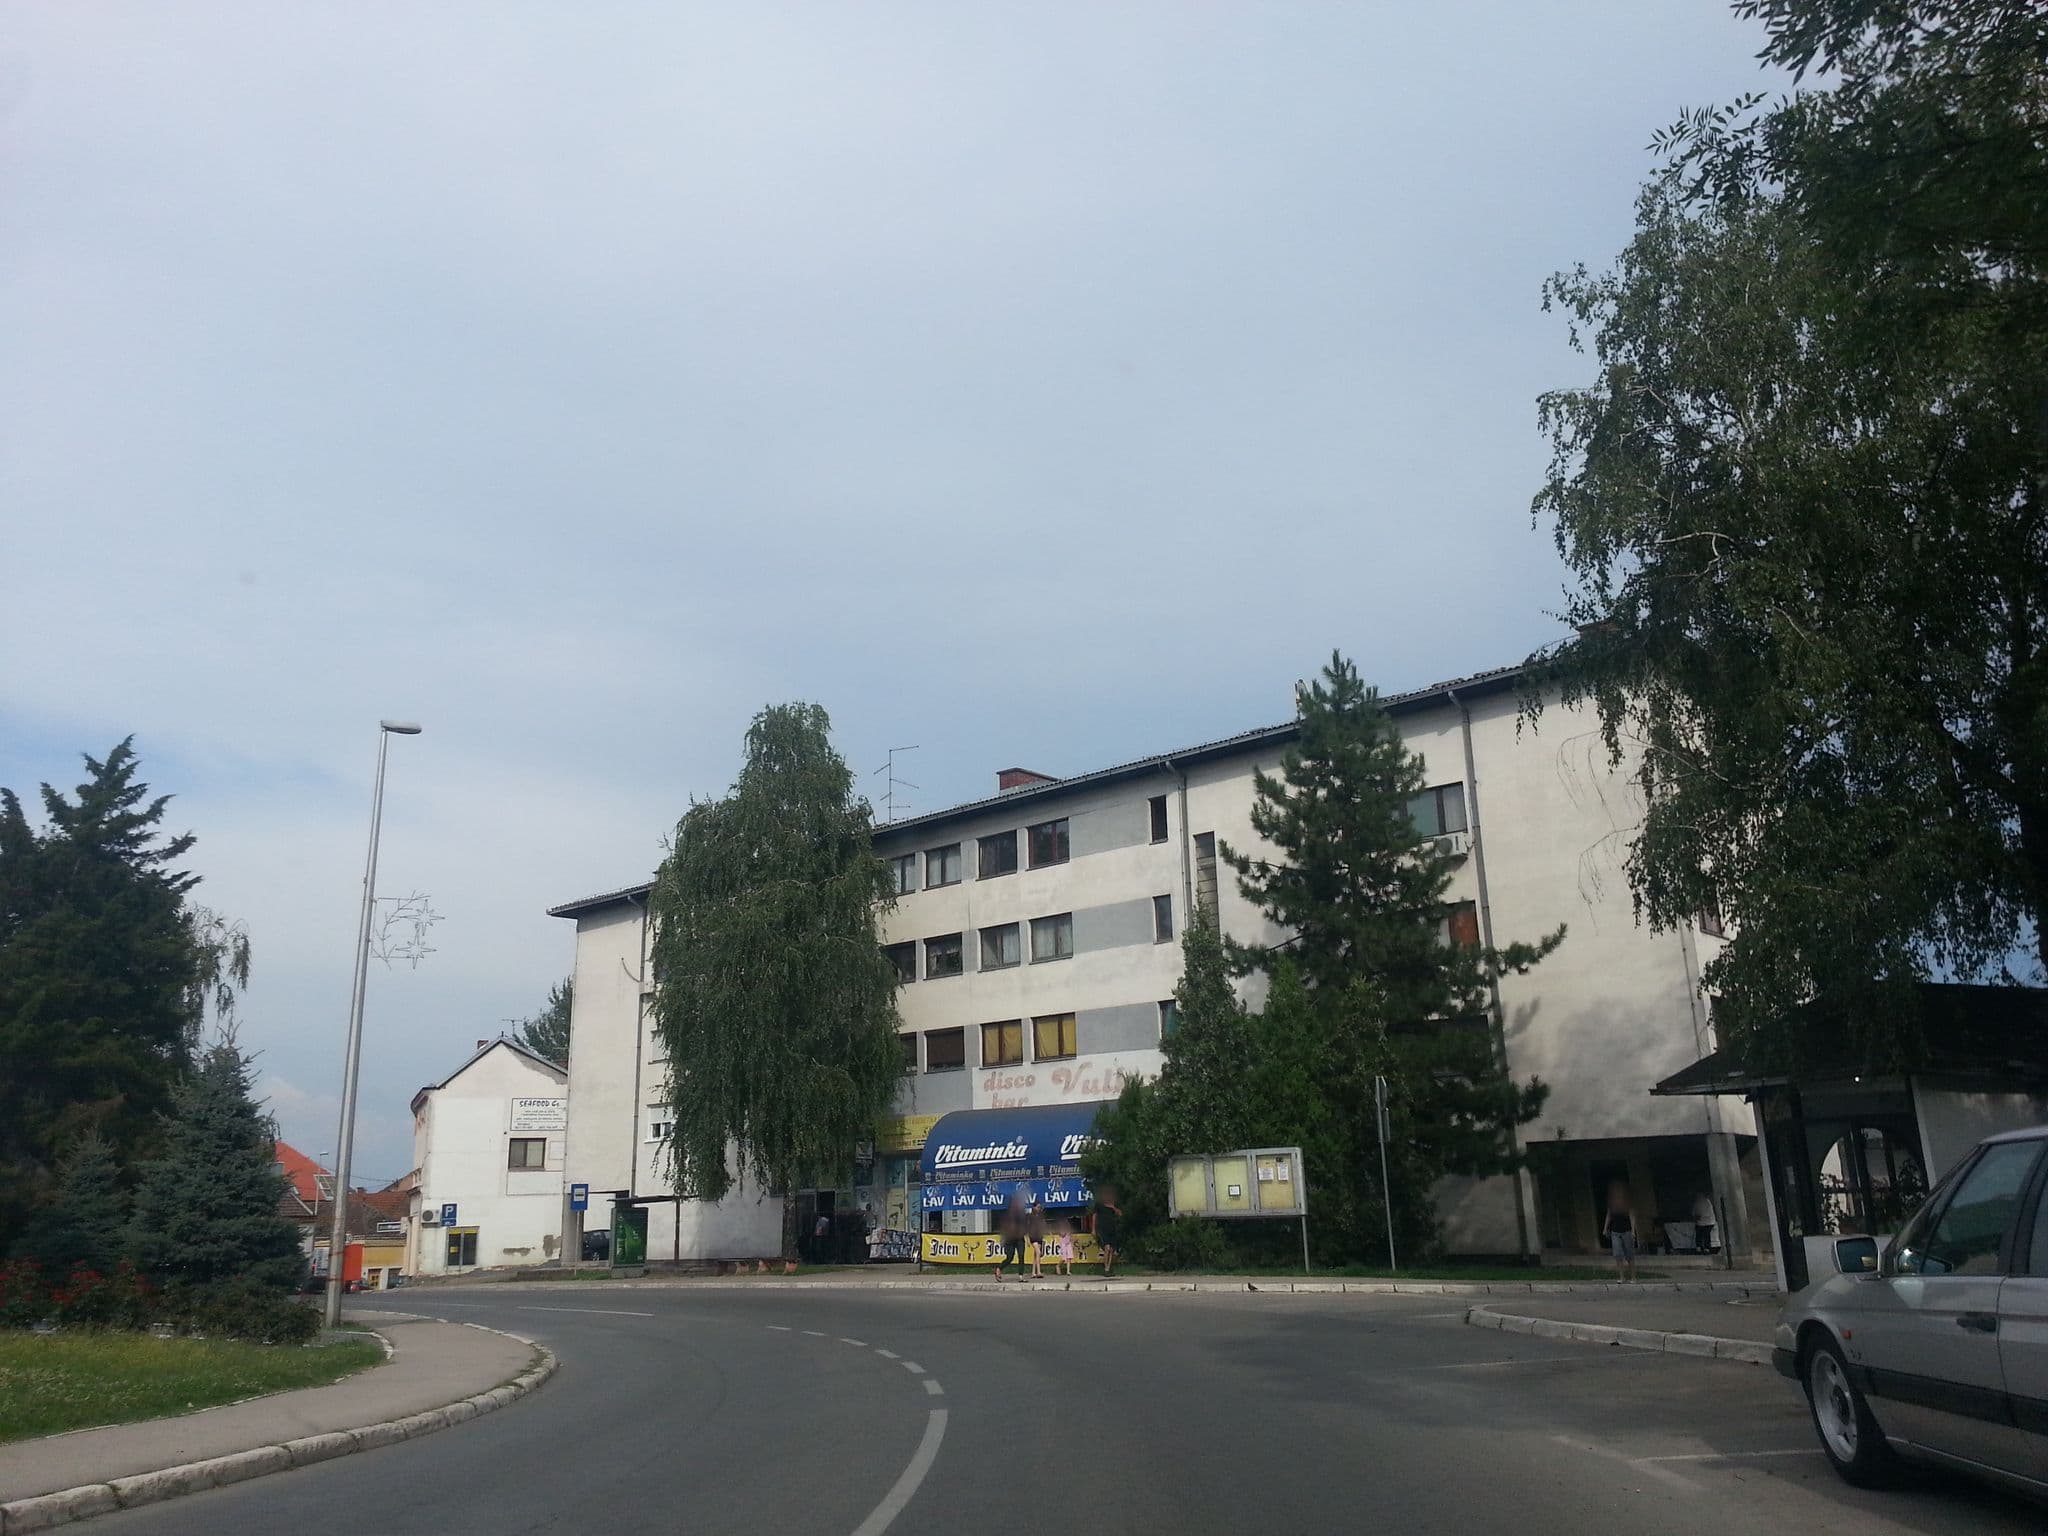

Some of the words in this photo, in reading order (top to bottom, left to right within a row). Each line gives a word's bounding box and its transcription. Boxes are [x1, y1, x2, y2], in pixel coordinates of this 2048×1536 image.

[984, 1071, 1036, 1092] disco
[519, 1099, 550, 1108] SEAFOOD
[991, 1093, 1029, 1109] bar
[934, 1140, 1029, 1164] Vitaminka
[989, 1166, 1032, 1178] Vitaminka
[922, 1195, 945, 1208] LAV
[952, 1194, 975, 1206] LAV
[982, 1193, 1004, 1206] LAV
[1044, 1191, 1070, 1204] LAV
[445, 1206, 454, 1217] P
[929, 1237, 960, 1257] Jelen
